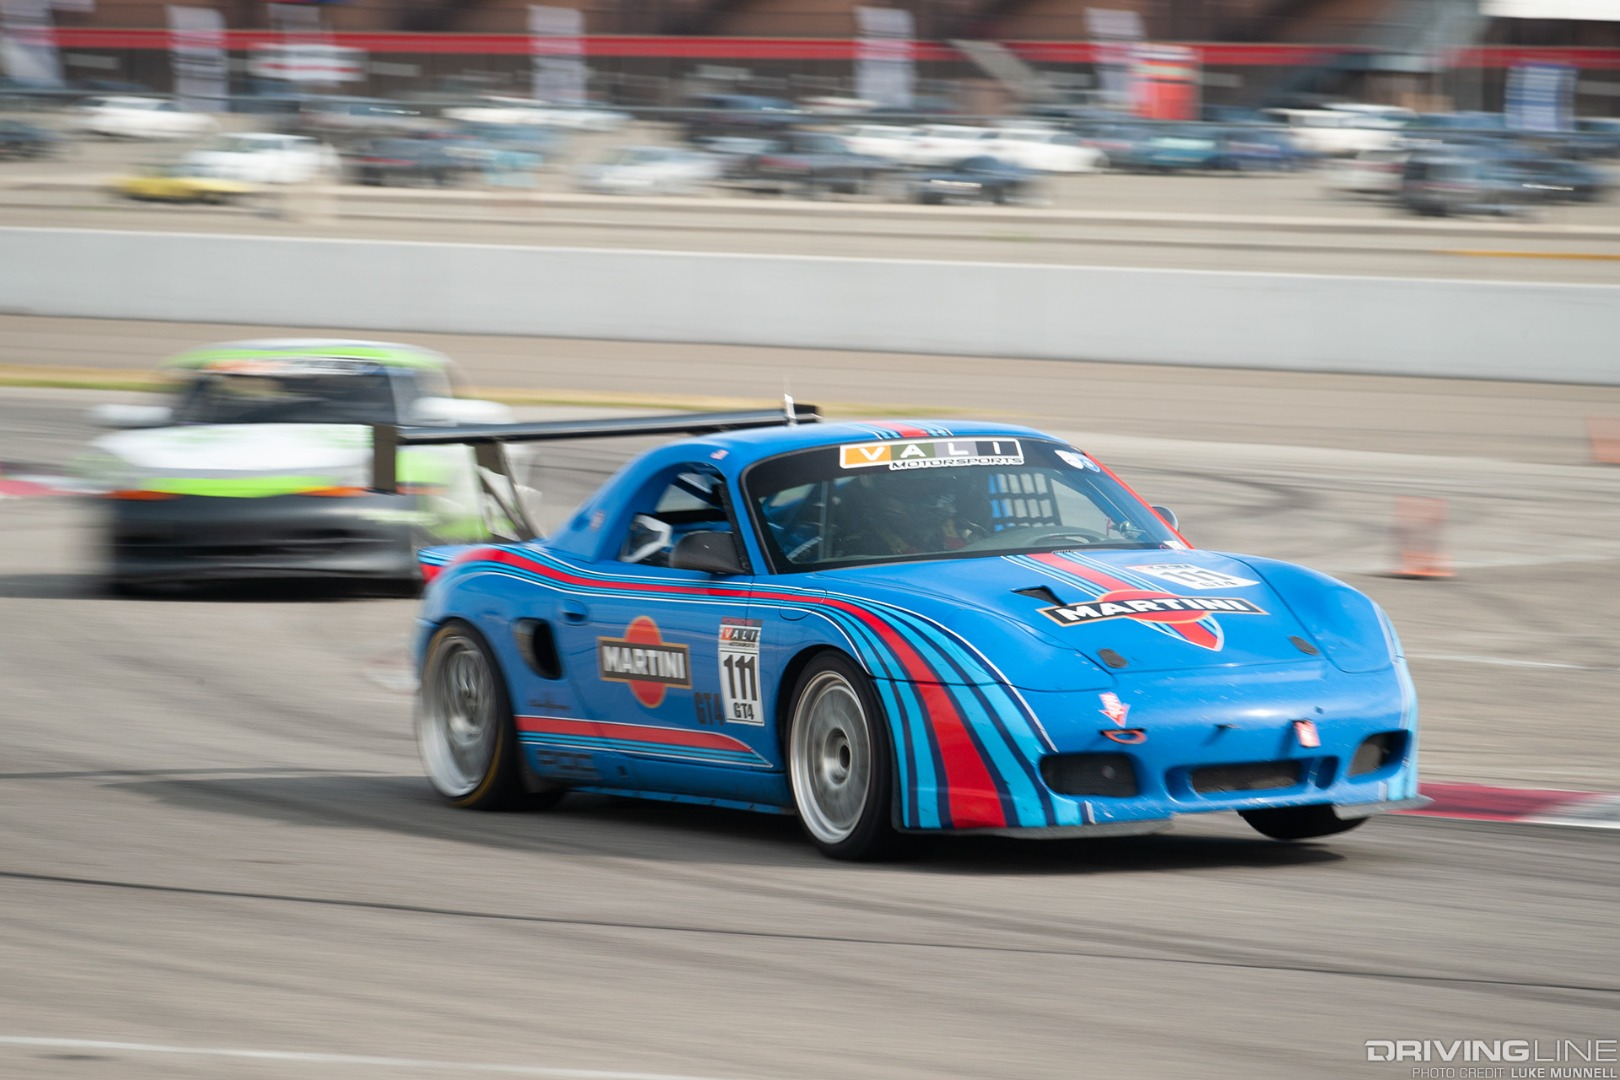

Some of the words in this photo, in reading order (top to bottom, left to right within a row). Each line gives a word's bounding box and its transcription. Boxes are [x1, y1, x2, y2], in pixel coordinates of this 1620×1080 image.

[858, 441, 1002, 461] VALI
[892, 458, 1023, 469] MOTORSPORTS
[1057, 598, 1251, 621] MARTINI
[724, 628, 756, 641] VALI
[602, 645, 686, 680] MARTINI
[723, 654, 758, 701] 111
[733, 702, 755, 720] GT4
